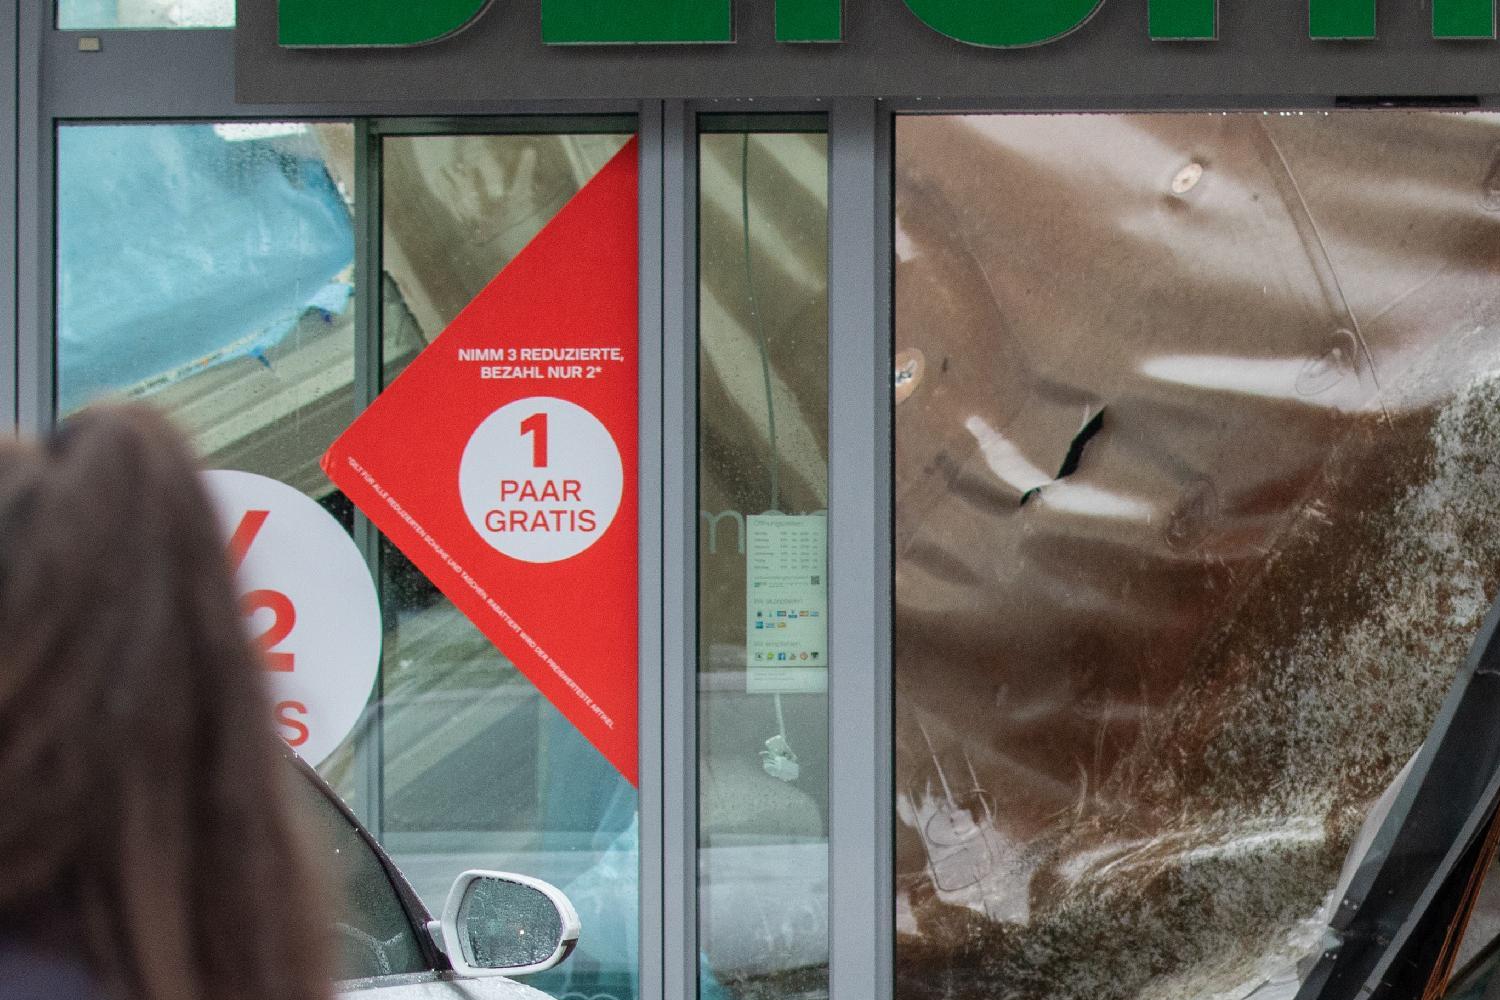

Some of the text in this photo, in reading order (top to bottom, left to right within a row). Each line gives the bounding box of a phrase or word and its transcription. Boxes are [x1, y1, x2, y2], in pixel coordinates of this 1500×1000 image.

[458, 348, 624, 363] NIMM 3 REDUZIERTE,
[480, 366, 544, 379] BEZAHL
[547, 366, 583, 378] NUR
[520, 413, 549, 468] 1
[500, 480, 582, 502] PAAR
[484, 509, 597, 533] GRATIS
